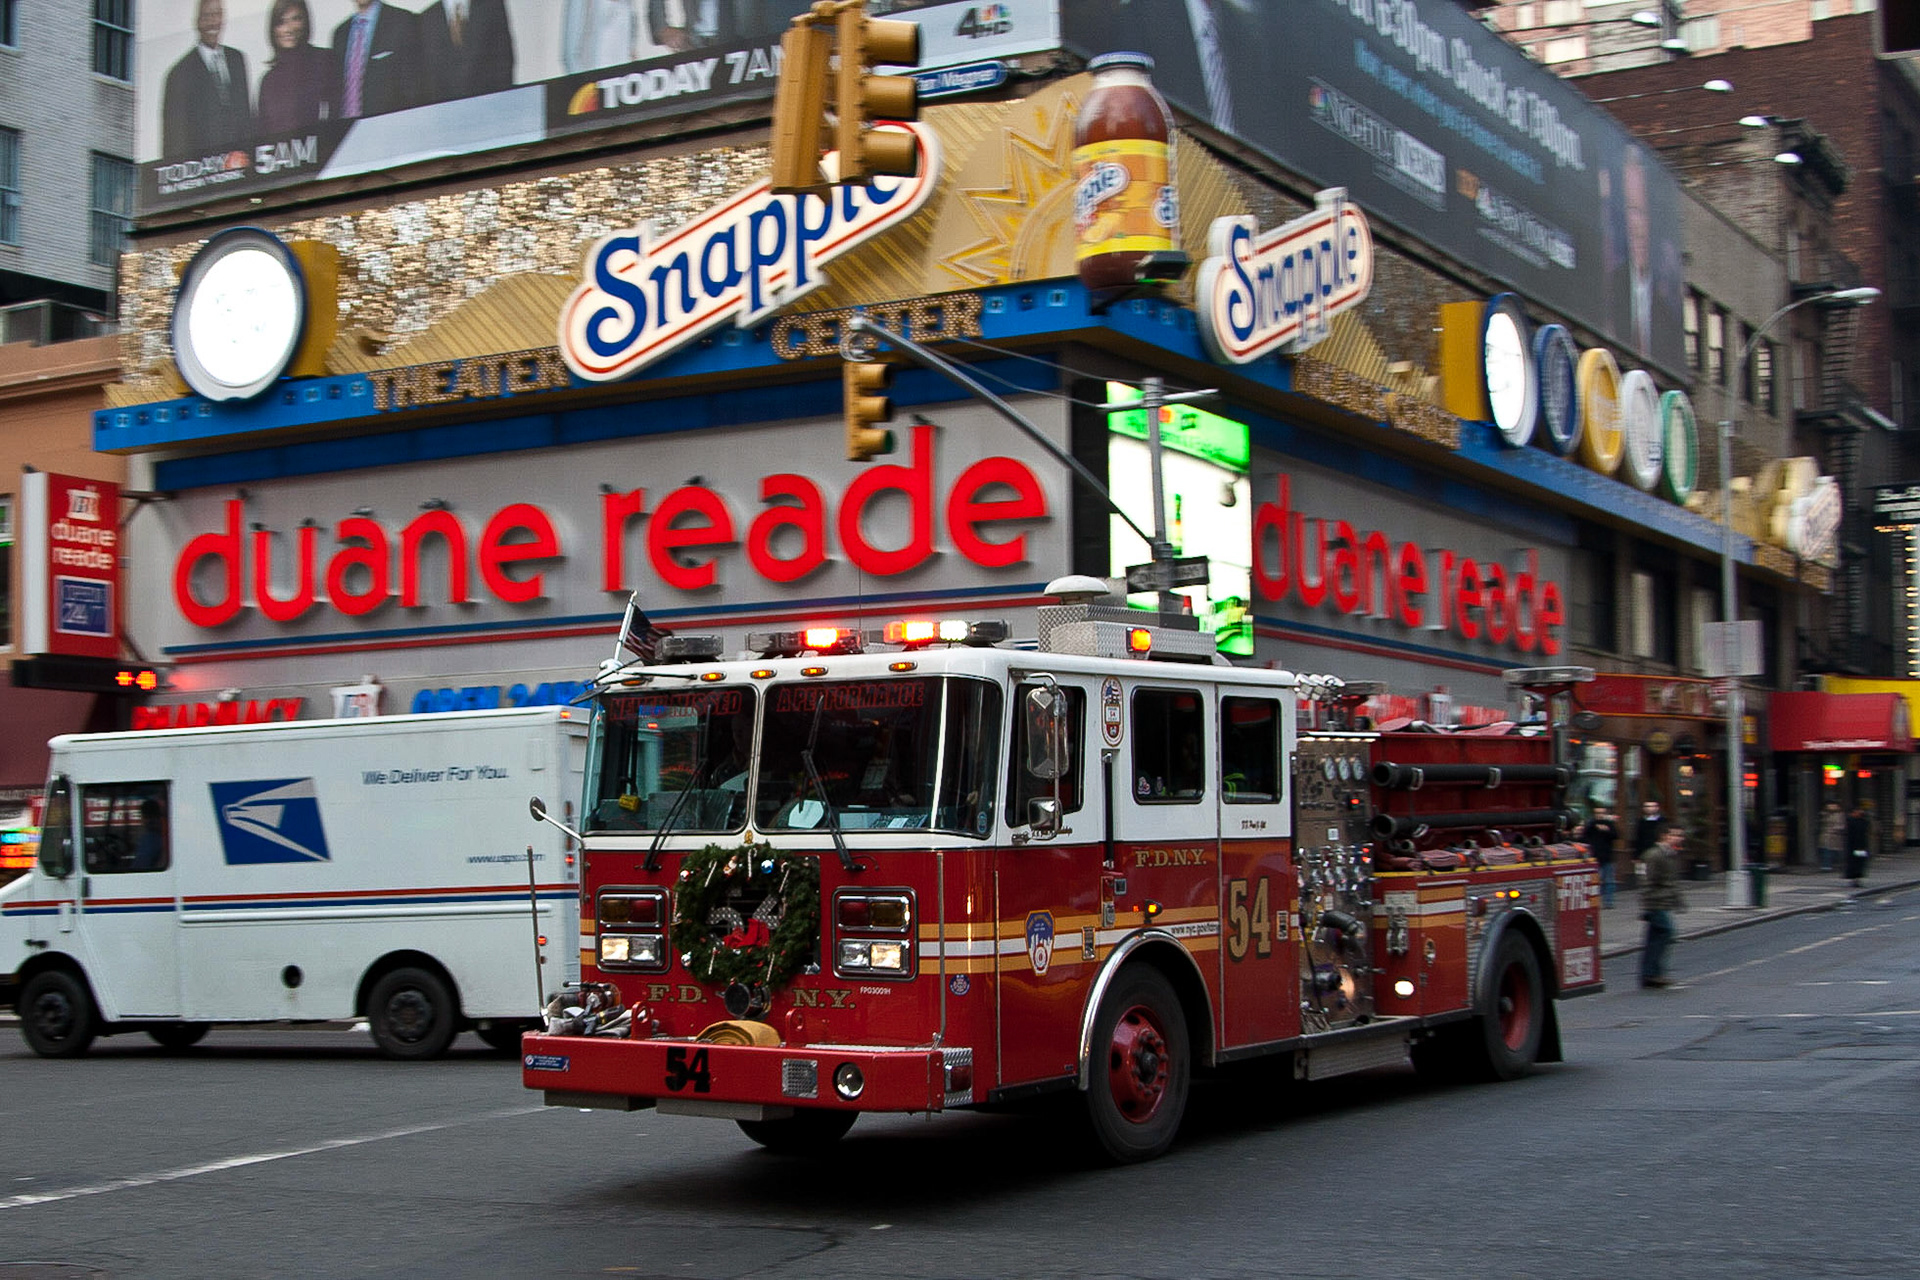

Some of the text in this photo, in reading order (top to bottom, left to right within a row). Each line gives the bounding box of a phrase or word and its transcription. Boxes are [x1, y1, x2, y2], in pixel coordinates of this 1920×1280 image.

[596, 57, 720, 109] TODAY
[154, 153, 226, 184] TODAY
[254, 135, 318, 174] 5AM
[585, 180, 903, 357] Snapp
[1228, 224, 1358, 345] Snapple
[51, 518, 117, 546] duane
[173, 424, 1047, 628] duane reade
[52, 546, 114, 569] reade
[1253, 472, 1565, 656] duane reade
[362, 770, 388, 785] We
[389, 768, 445, 784] Deliver
[447, 767, 474, 782] For
[1135, 848, 1207, 868] F.D.N.Y.
[1229, 876, 1271, 962] 54
[647, 984, 708, 1003] F.D.
[792, 989, 856, 1009] N.Y.
[665, 1046, 711, 1093] 54
